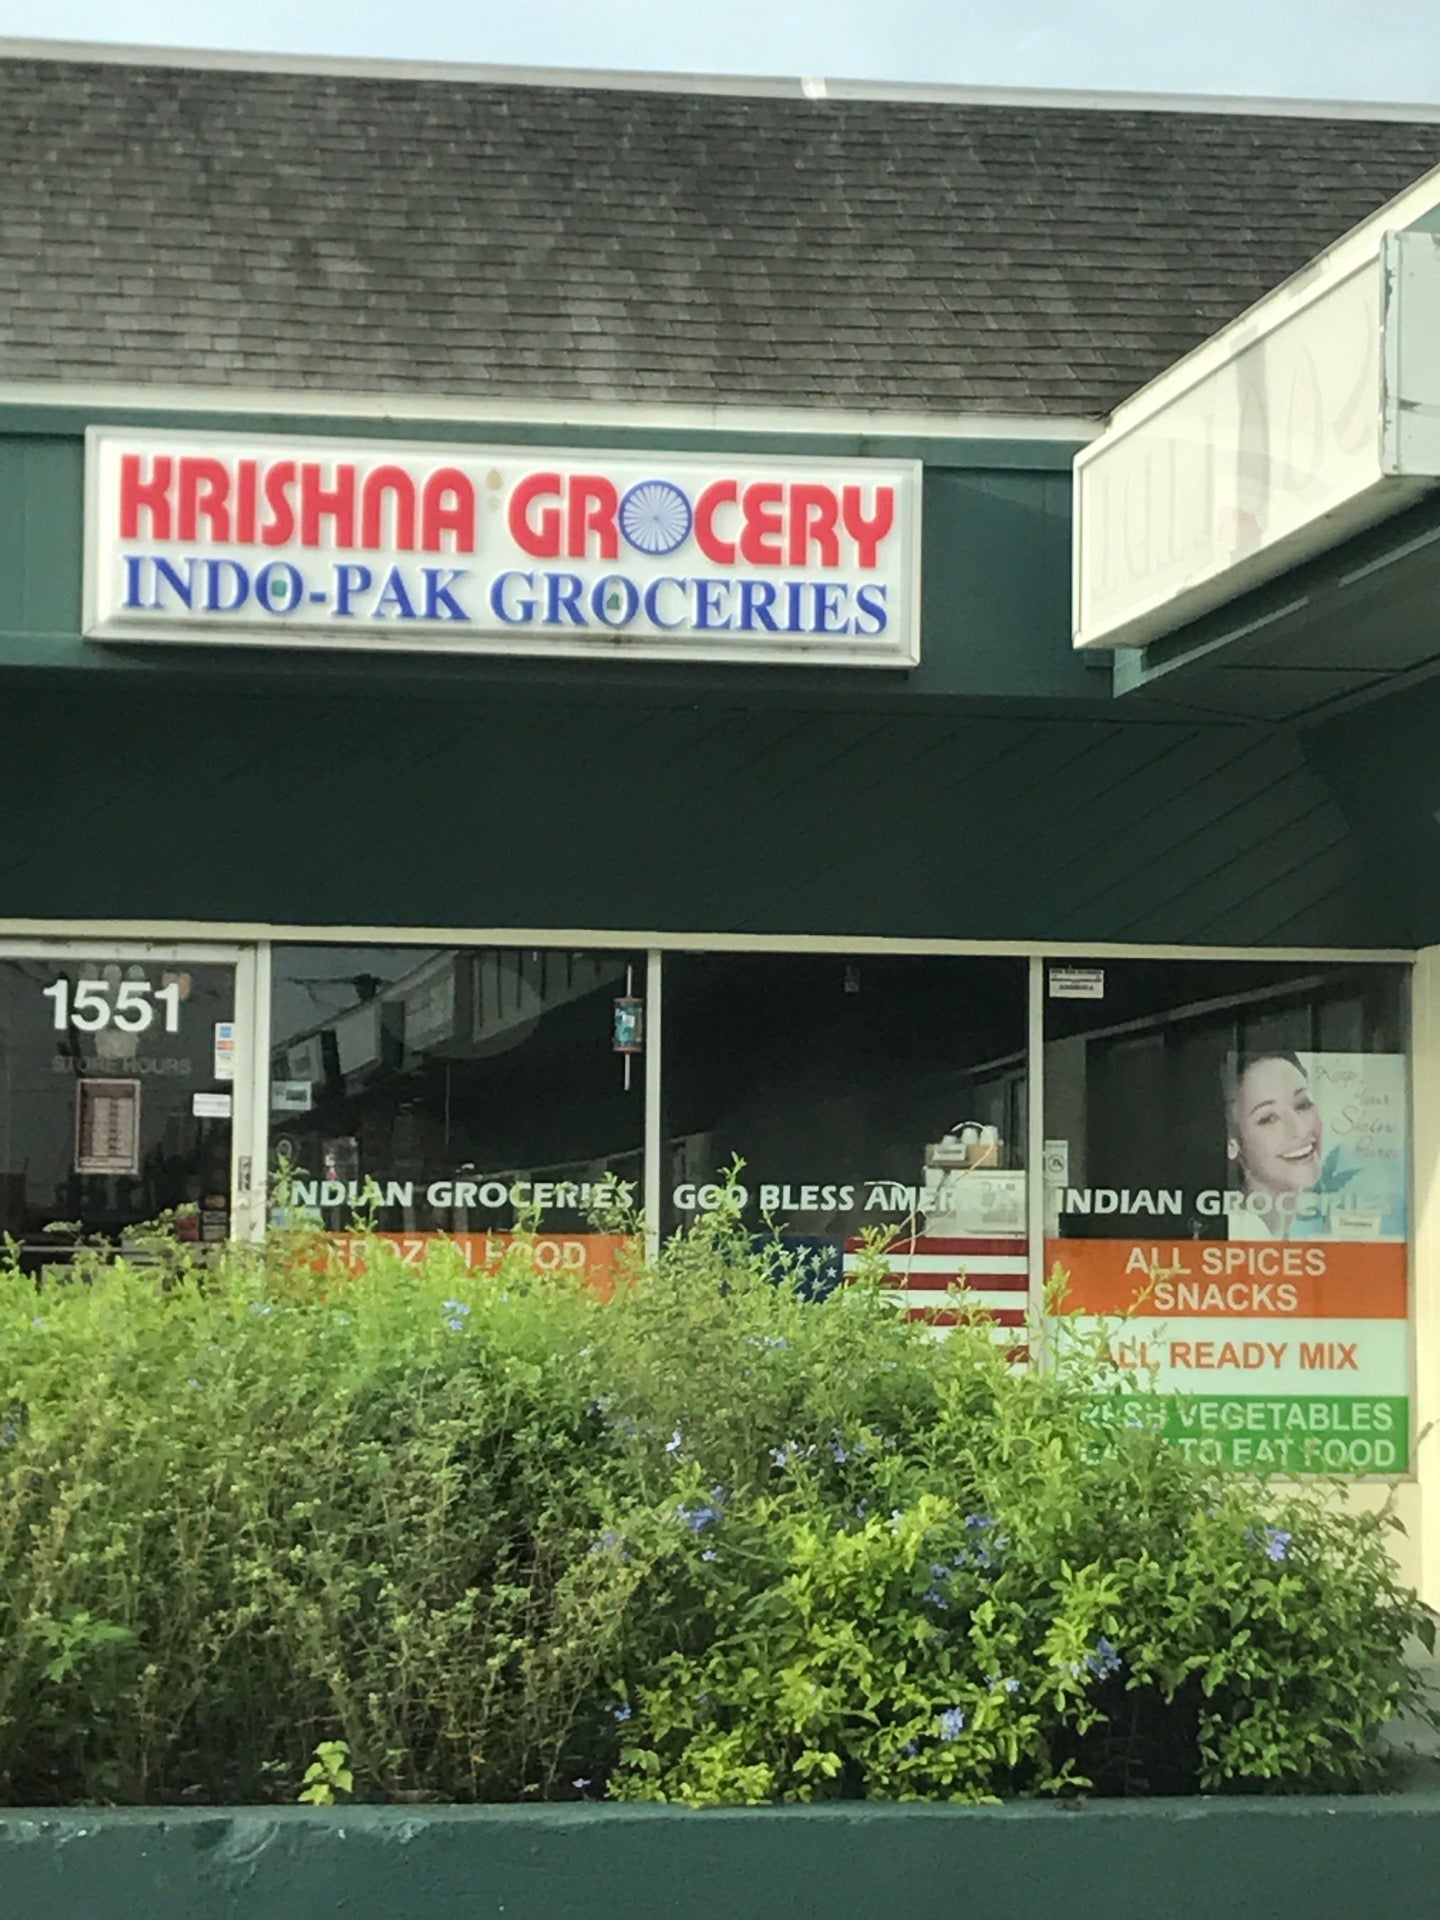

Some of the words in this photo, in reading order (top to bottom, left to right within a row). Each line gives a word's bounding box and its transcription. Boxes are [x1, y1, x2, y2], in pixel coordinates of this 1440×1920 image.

[119, 453, 476, 553] KRISHNA
[123, 554, 471, 621] INDO-PAK
[489, 570, 889, 636] GROCERIES
[43, 979, 180, 1032] 1551
[277, 1181, 413, 1207] NDIAN
[759, 1185, 855, 1211] BLESS
[1055, 1188, 1183, 1215] INDIAN
[1125, 1247, 1191, 1275] ALL
[1202, 1248, 1326, 1276] SPICES
[1153, 1283, 1298, 1311] SNACKS
[1169, 1341, 1289, 1370] READY
[1299, 1342, 1360, 1371] MIX
[1177, 1402, 1394, 1432] VEGETABLES
[1179, 1437, 1223, 1466] TO
[1232, 1438, 1294, 1467] EAT
[1303, 1438, 1397, 1467] FOOD
